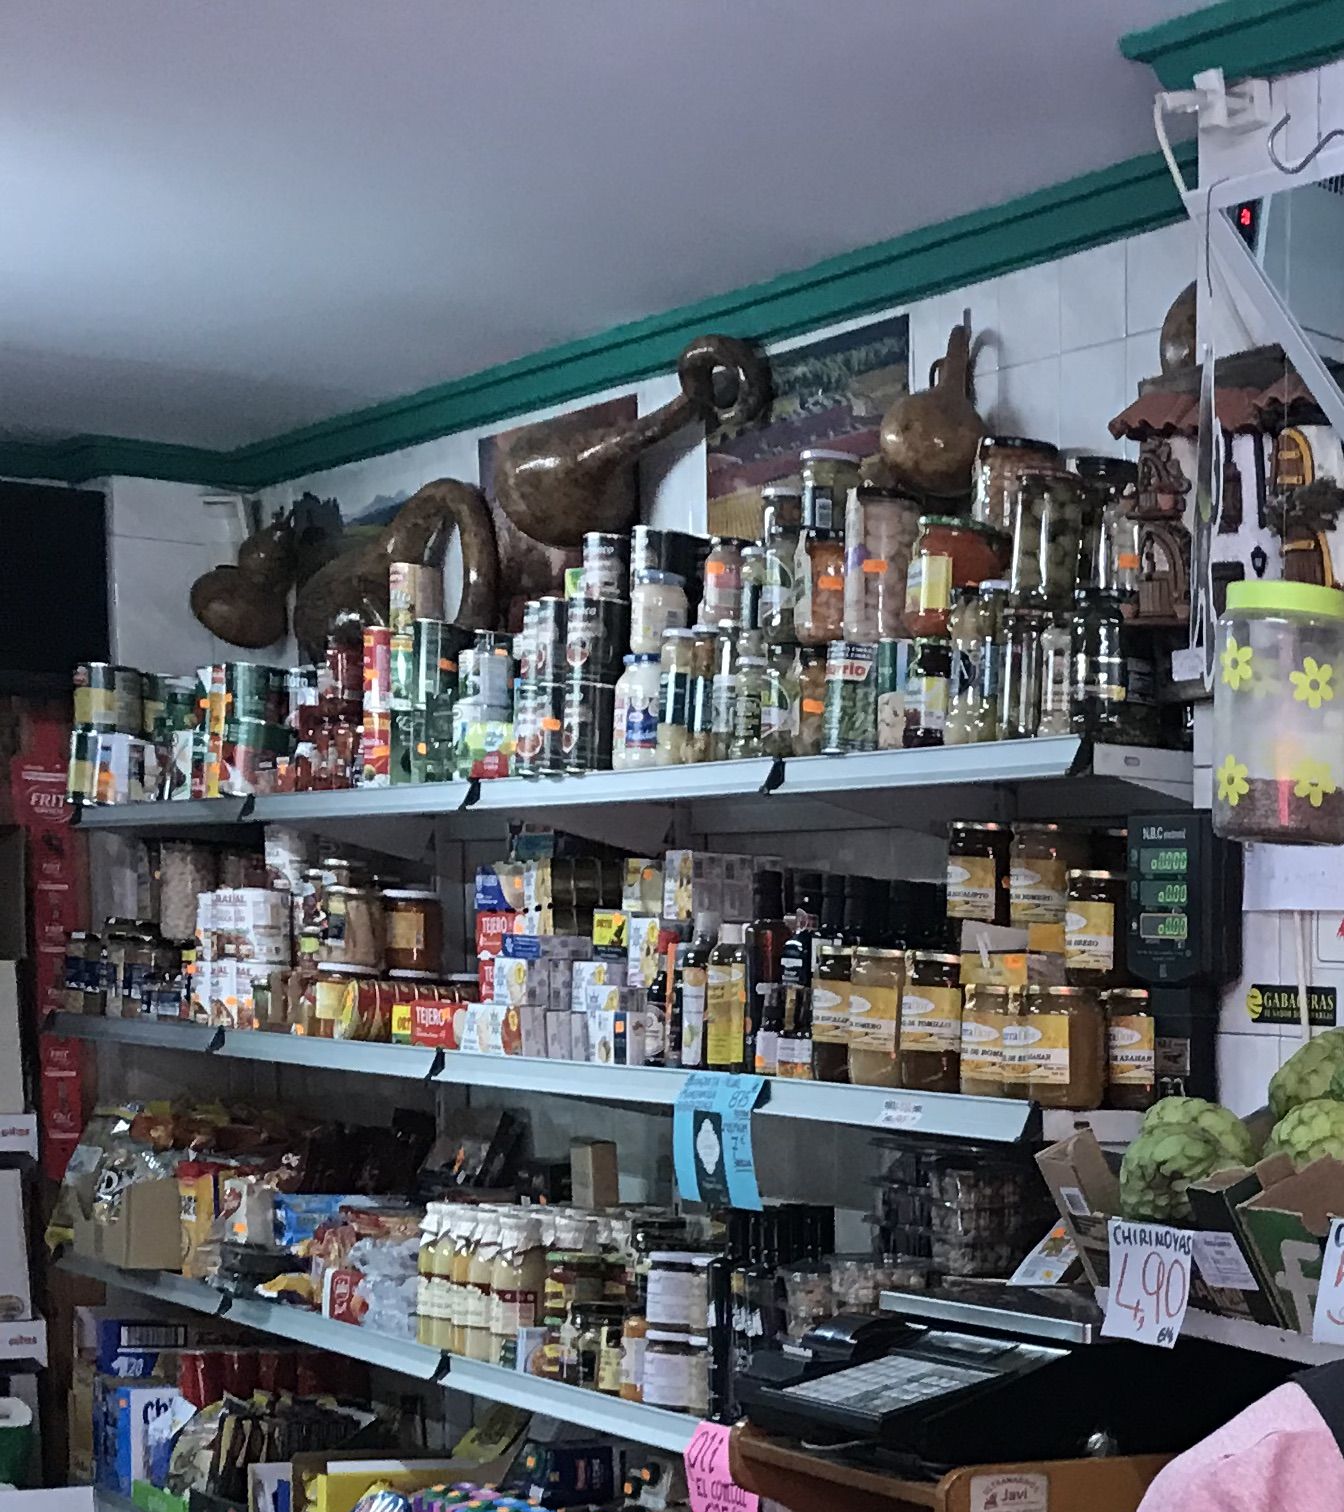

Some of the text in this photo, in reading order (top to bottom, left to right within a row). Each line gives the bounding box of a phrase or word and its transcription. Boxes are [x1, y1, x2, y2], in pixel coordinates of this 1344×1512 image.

[1112, 1225, 1193, 1257] CHIRIMOYAS
[1114, 1250, 1186, 1333] 4,90
[1001, 1488, 1028, 1502] Javi
